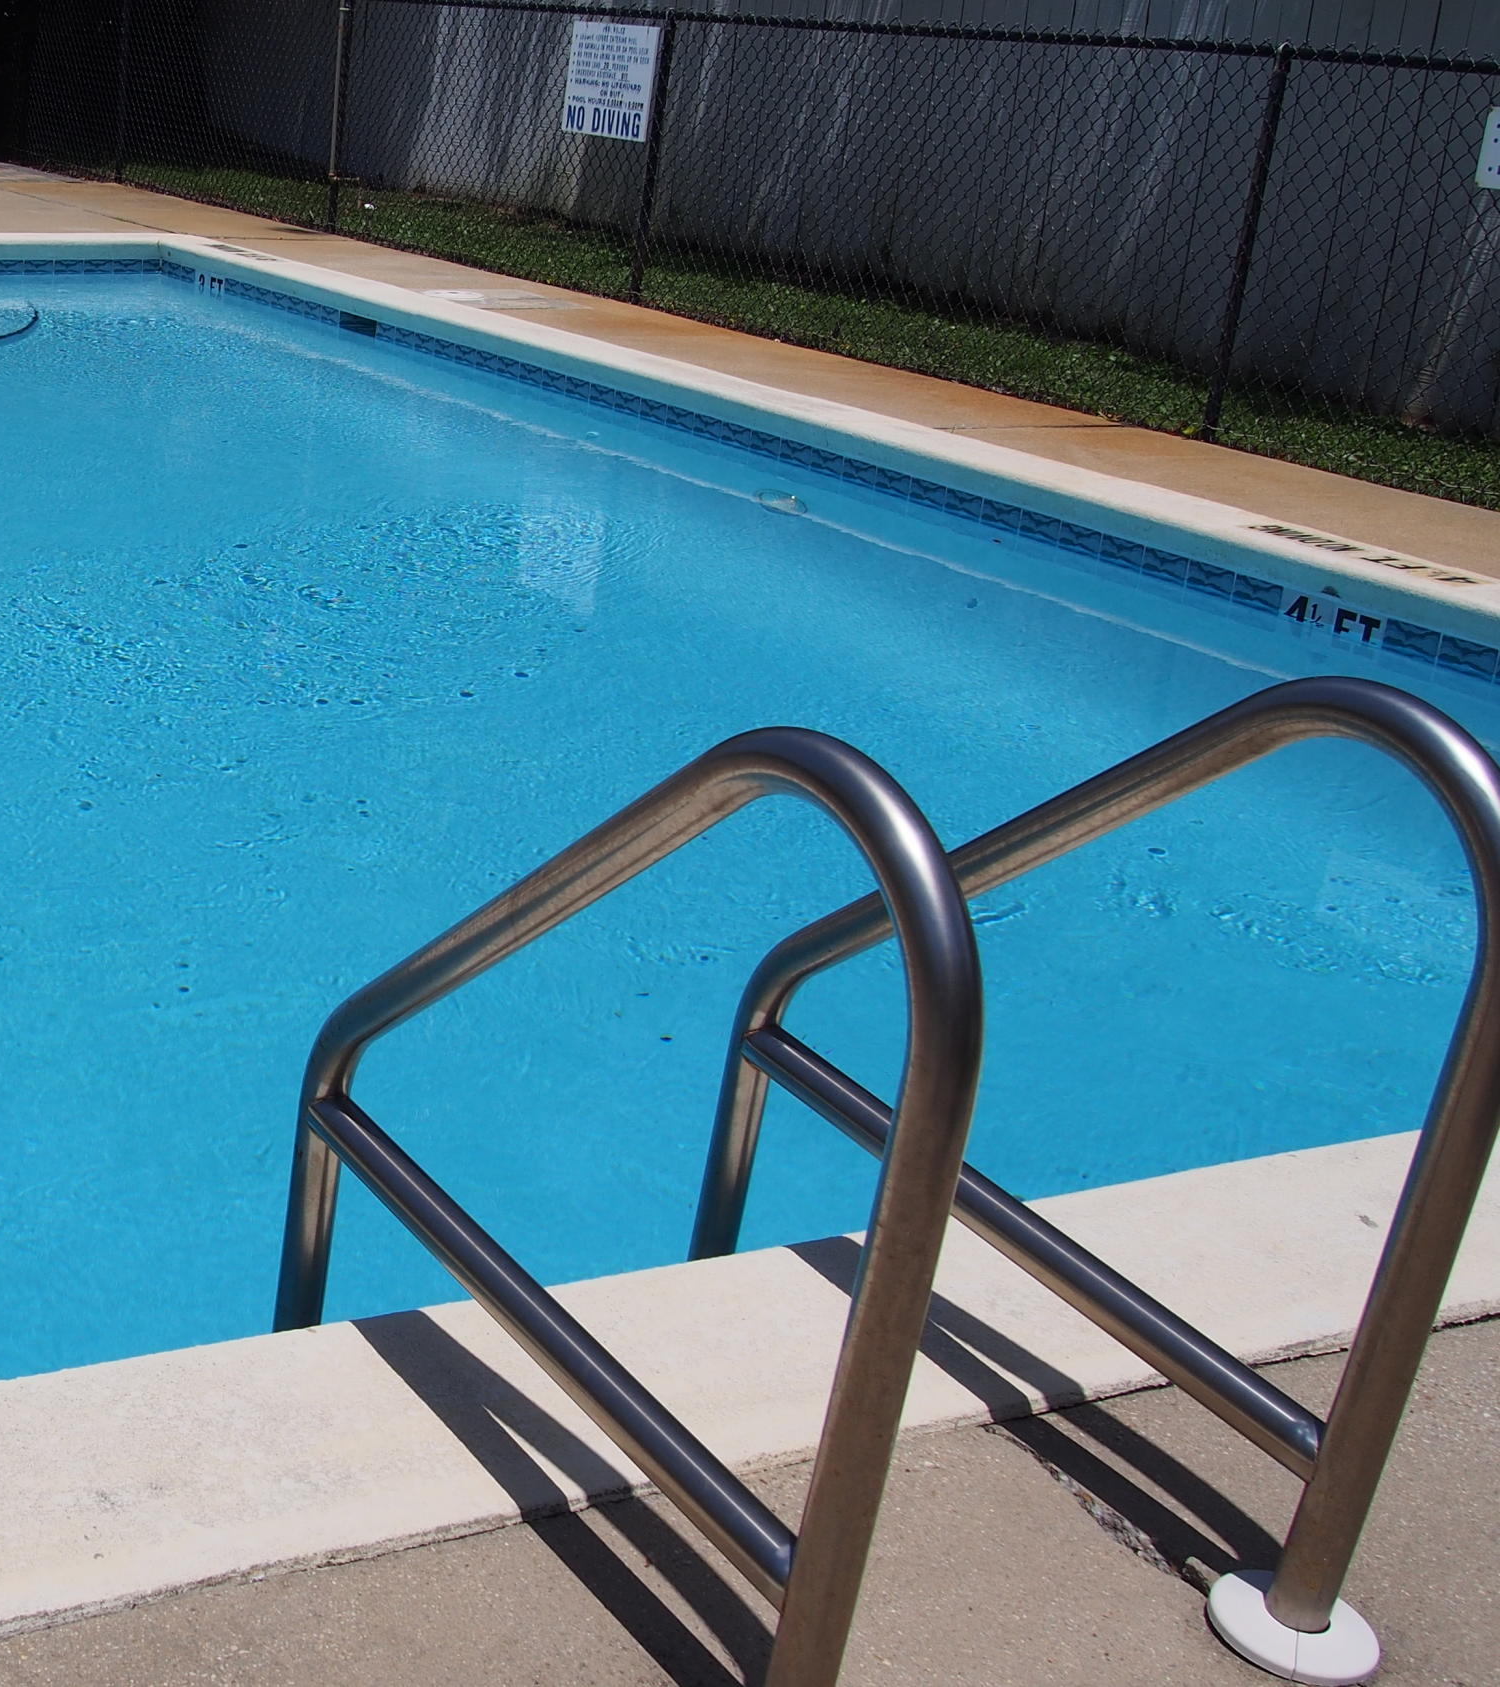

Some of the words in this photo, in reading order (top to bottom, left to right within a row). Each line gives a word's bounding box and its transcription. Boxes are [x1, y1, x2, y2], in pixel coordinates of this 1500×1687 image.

[566, 105, 585, 131] NO
[591, 108, 641, 138] DIVING
[1333, 608, 1381, 643] FT
